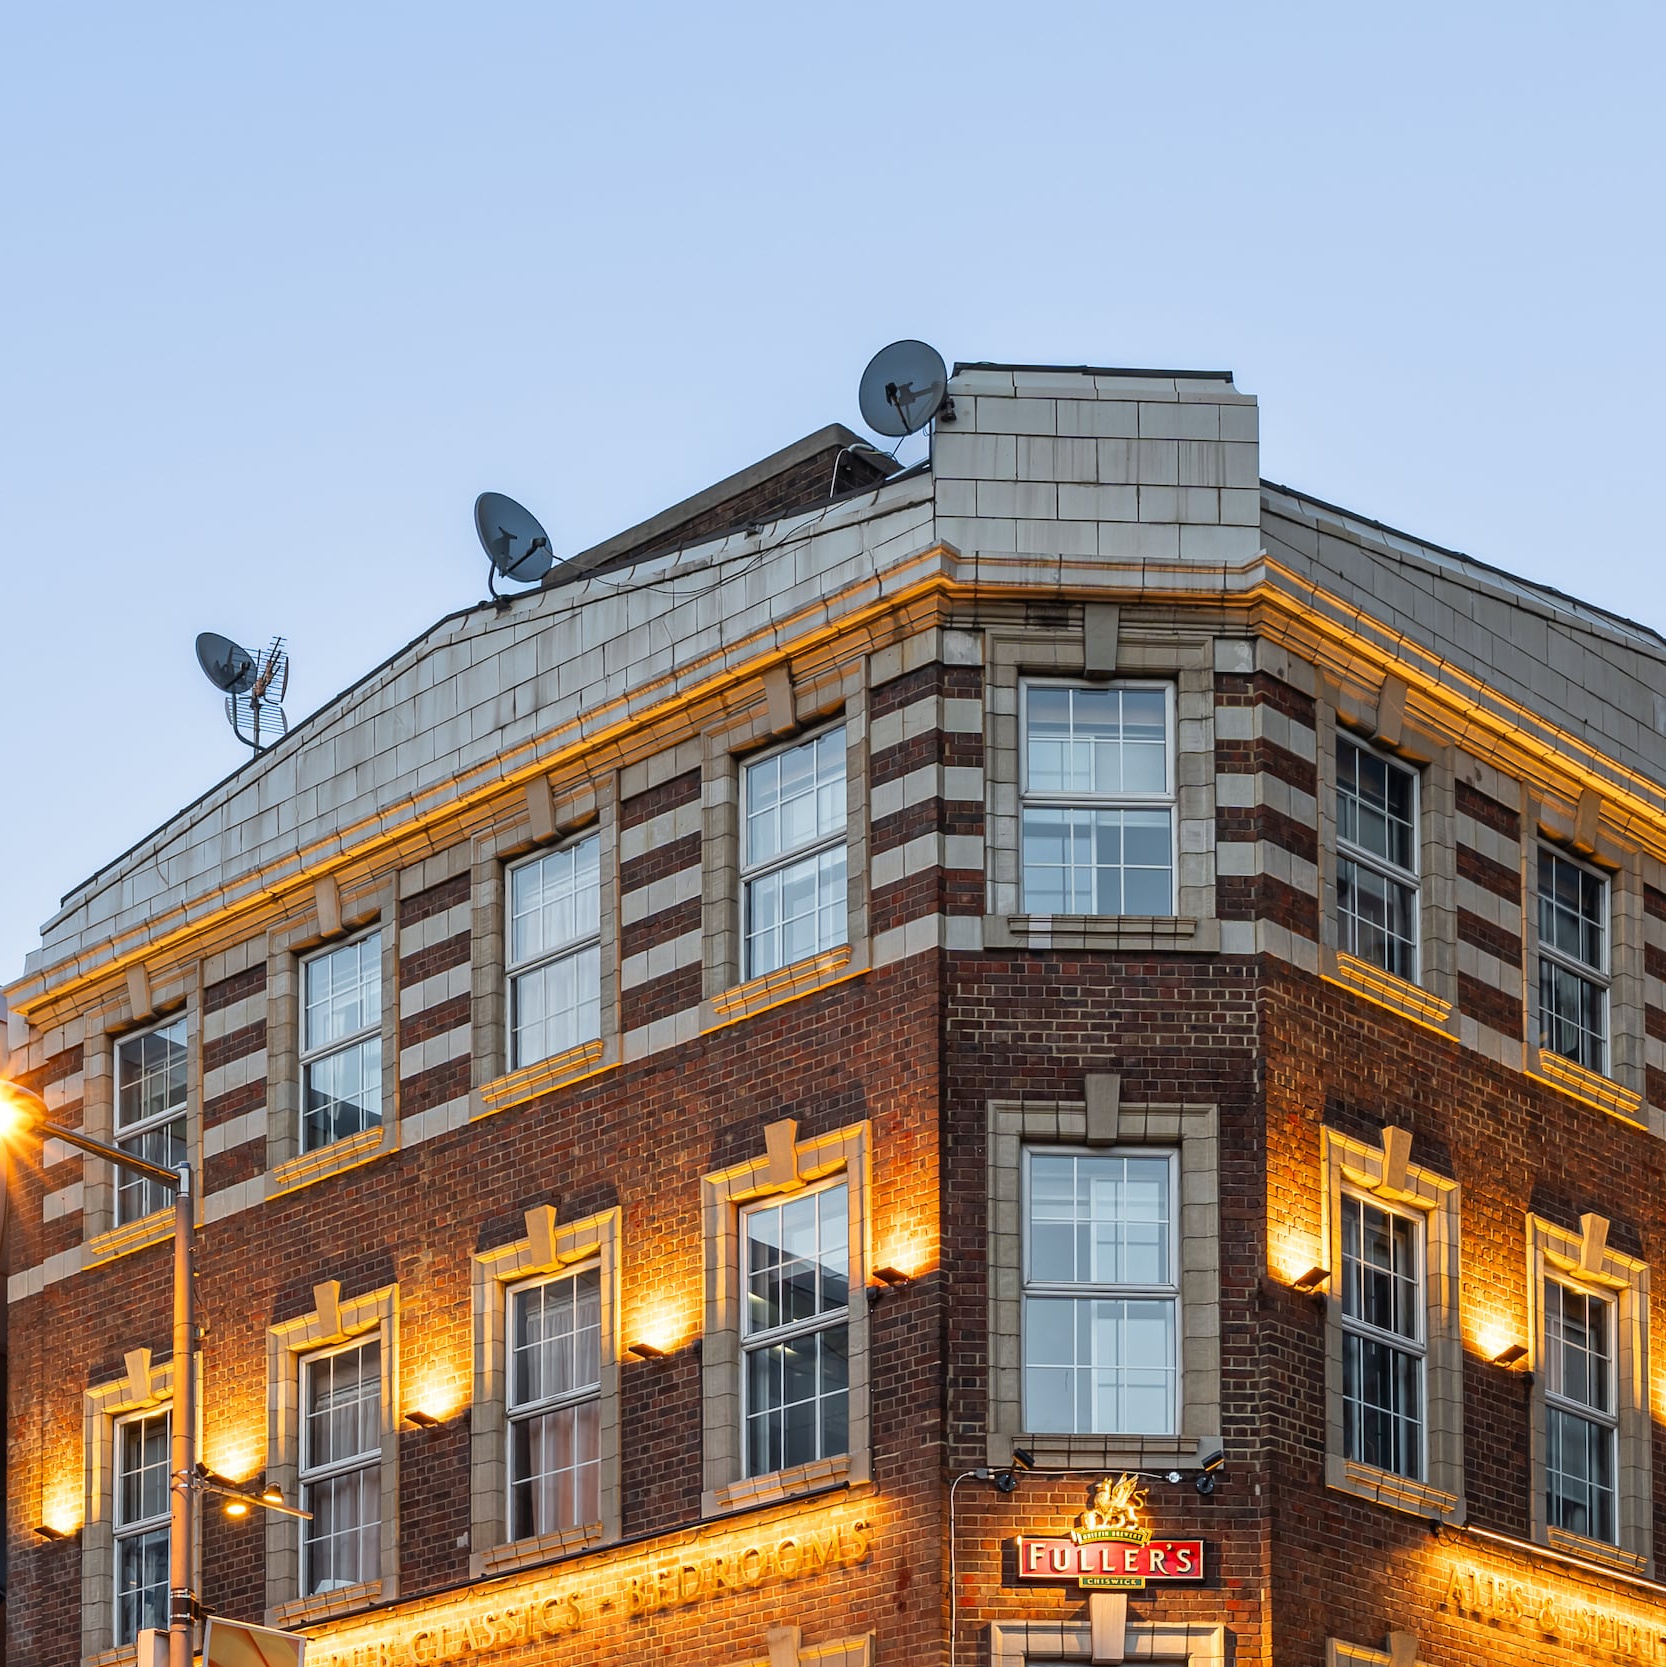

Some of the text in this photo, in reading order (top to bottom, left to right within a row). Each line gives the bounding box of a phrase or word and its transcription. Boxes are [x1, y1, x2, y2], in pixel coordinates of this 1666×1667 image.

[629, 1520, 870, 1612] BEDROOMS
[1029, 1543, 1192, 1575] FULLER'S
[409, 1591, 582, 1664] CLASSICS
[1447, 1567, 1523, 1618] ALES
[1539, 1598, 1559, 1631] &
